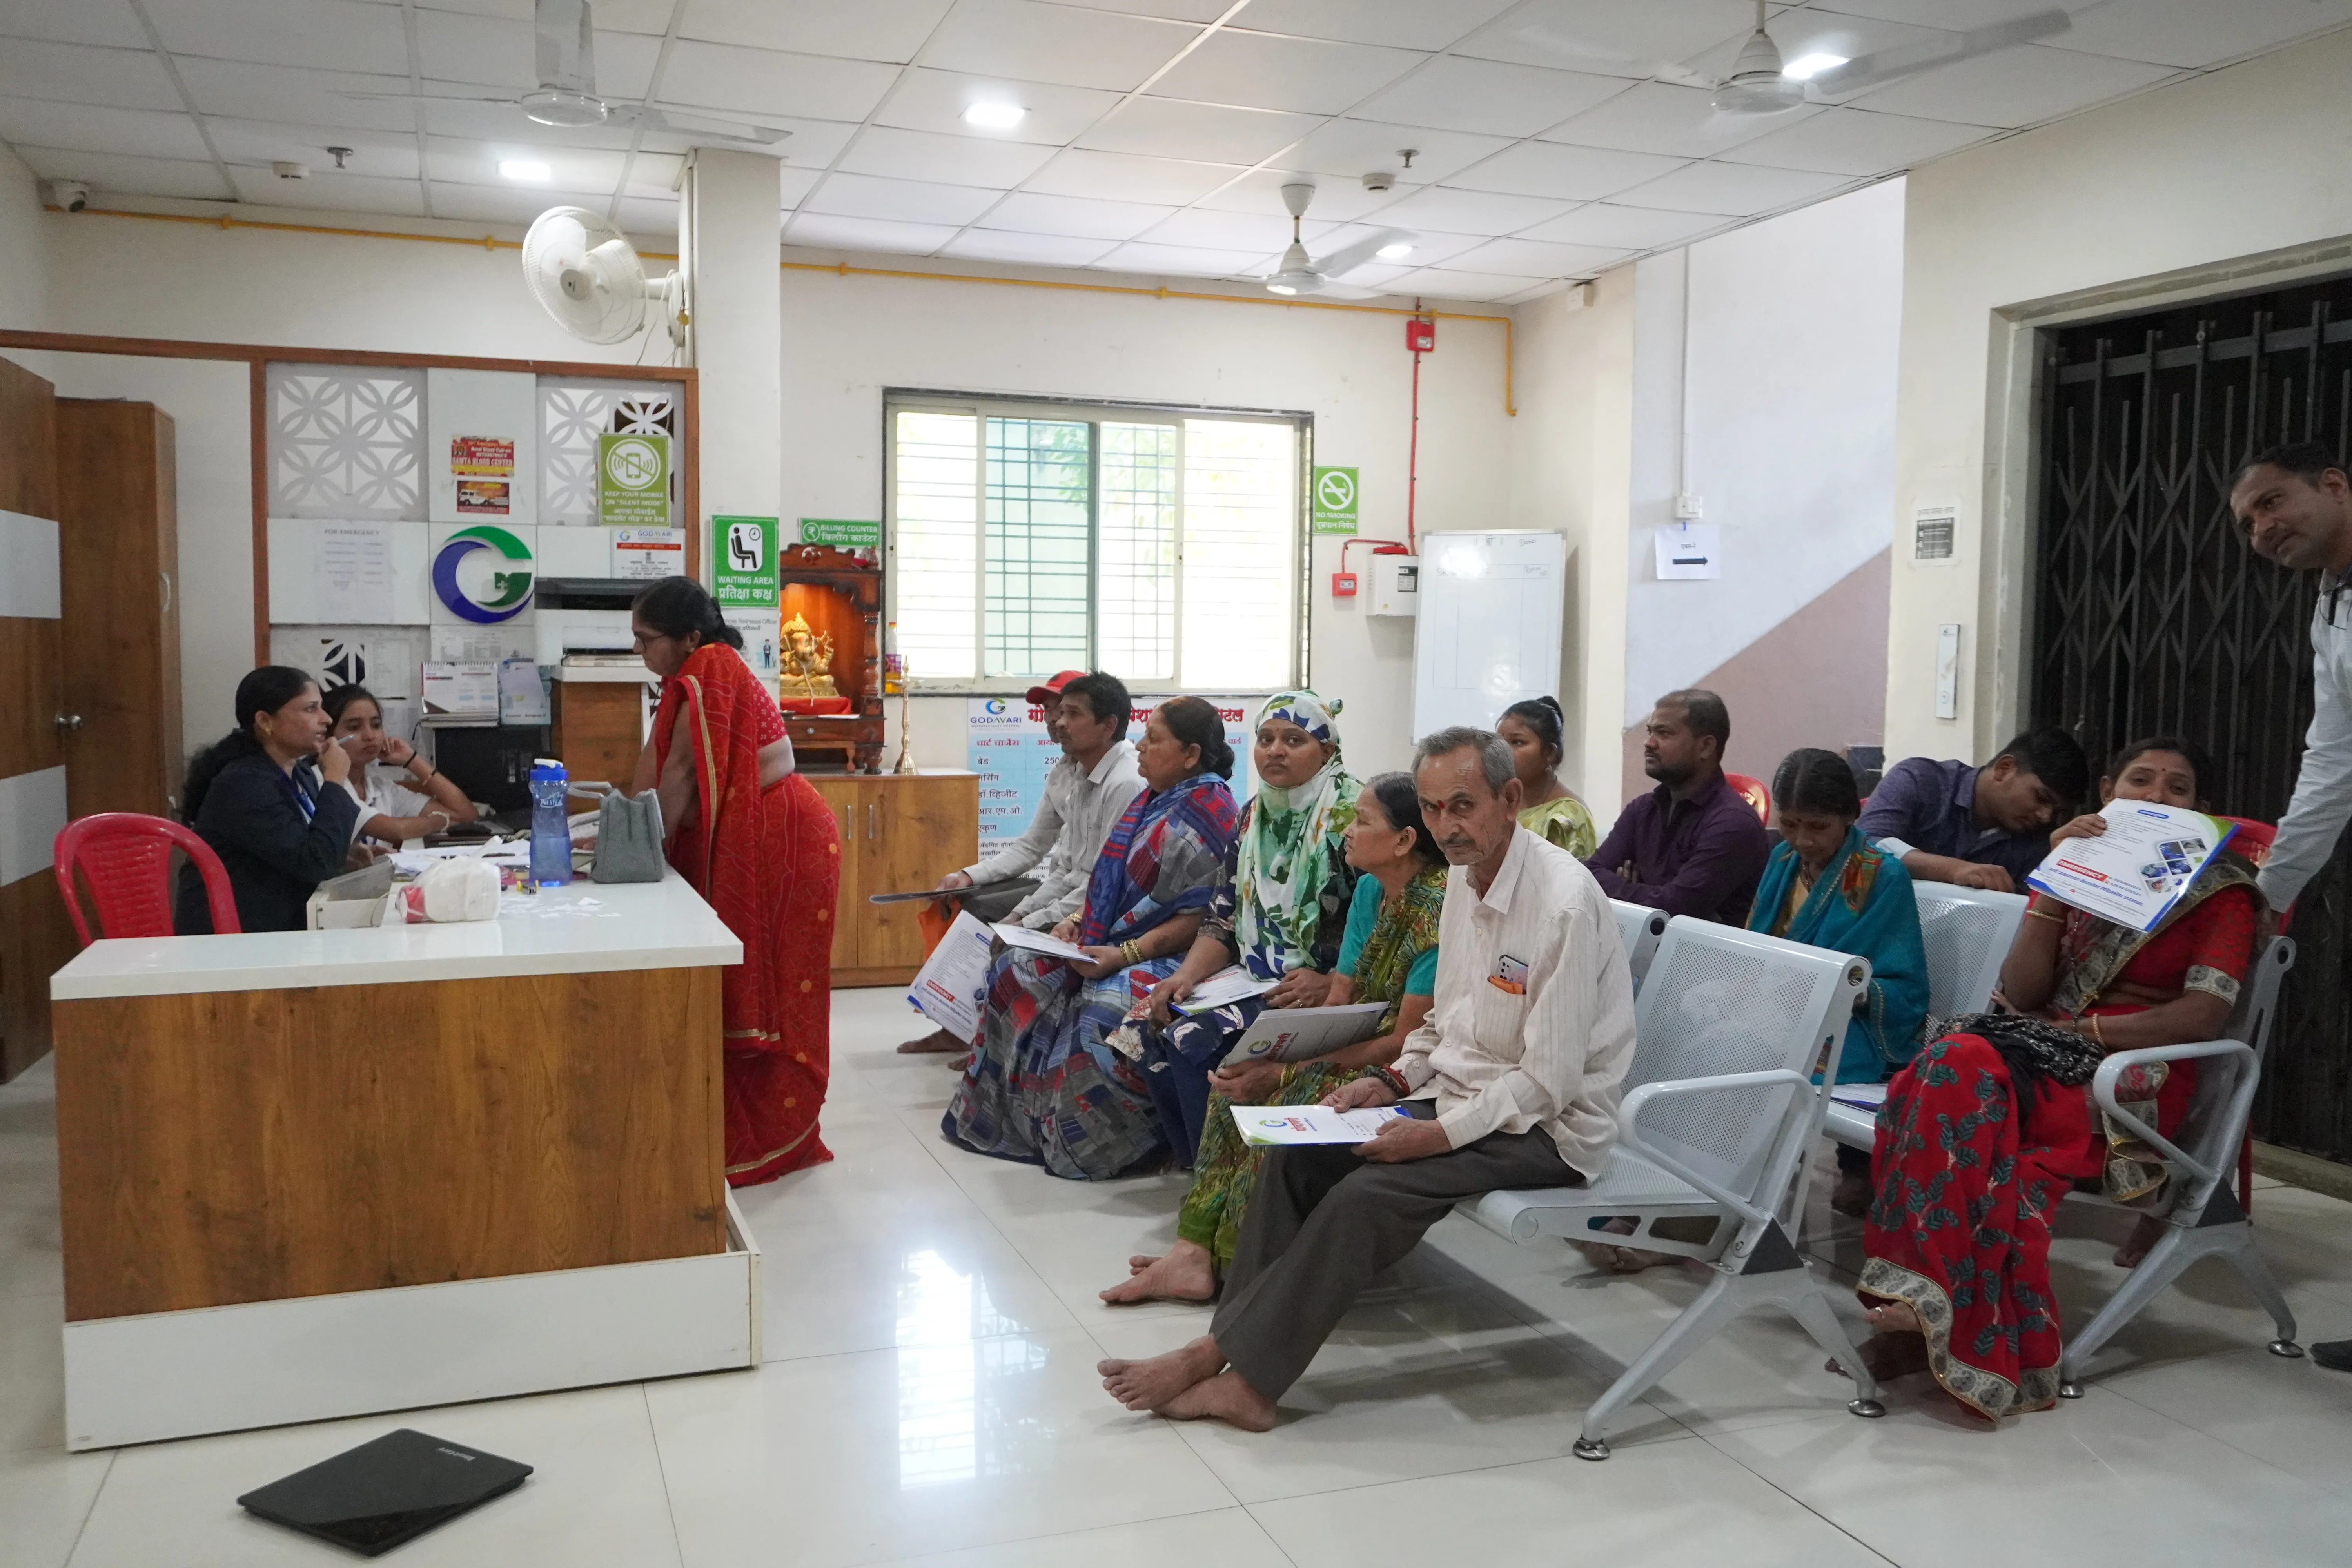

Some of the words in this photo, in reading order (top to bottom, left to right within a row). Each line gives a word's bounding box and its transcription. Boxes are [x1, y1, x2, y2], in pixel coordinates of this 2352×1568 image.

[717, 576, 751, 584] WAITING
[718, 584, 750, 600] प्रतिक्षा
[751, 588, 773, 601] कक्ष
[977, 756, 989, 765] बेड
[2059, 860, 2104, 879] EMERGENCY
[927, 980, 953, 1001] EMERGENCY
